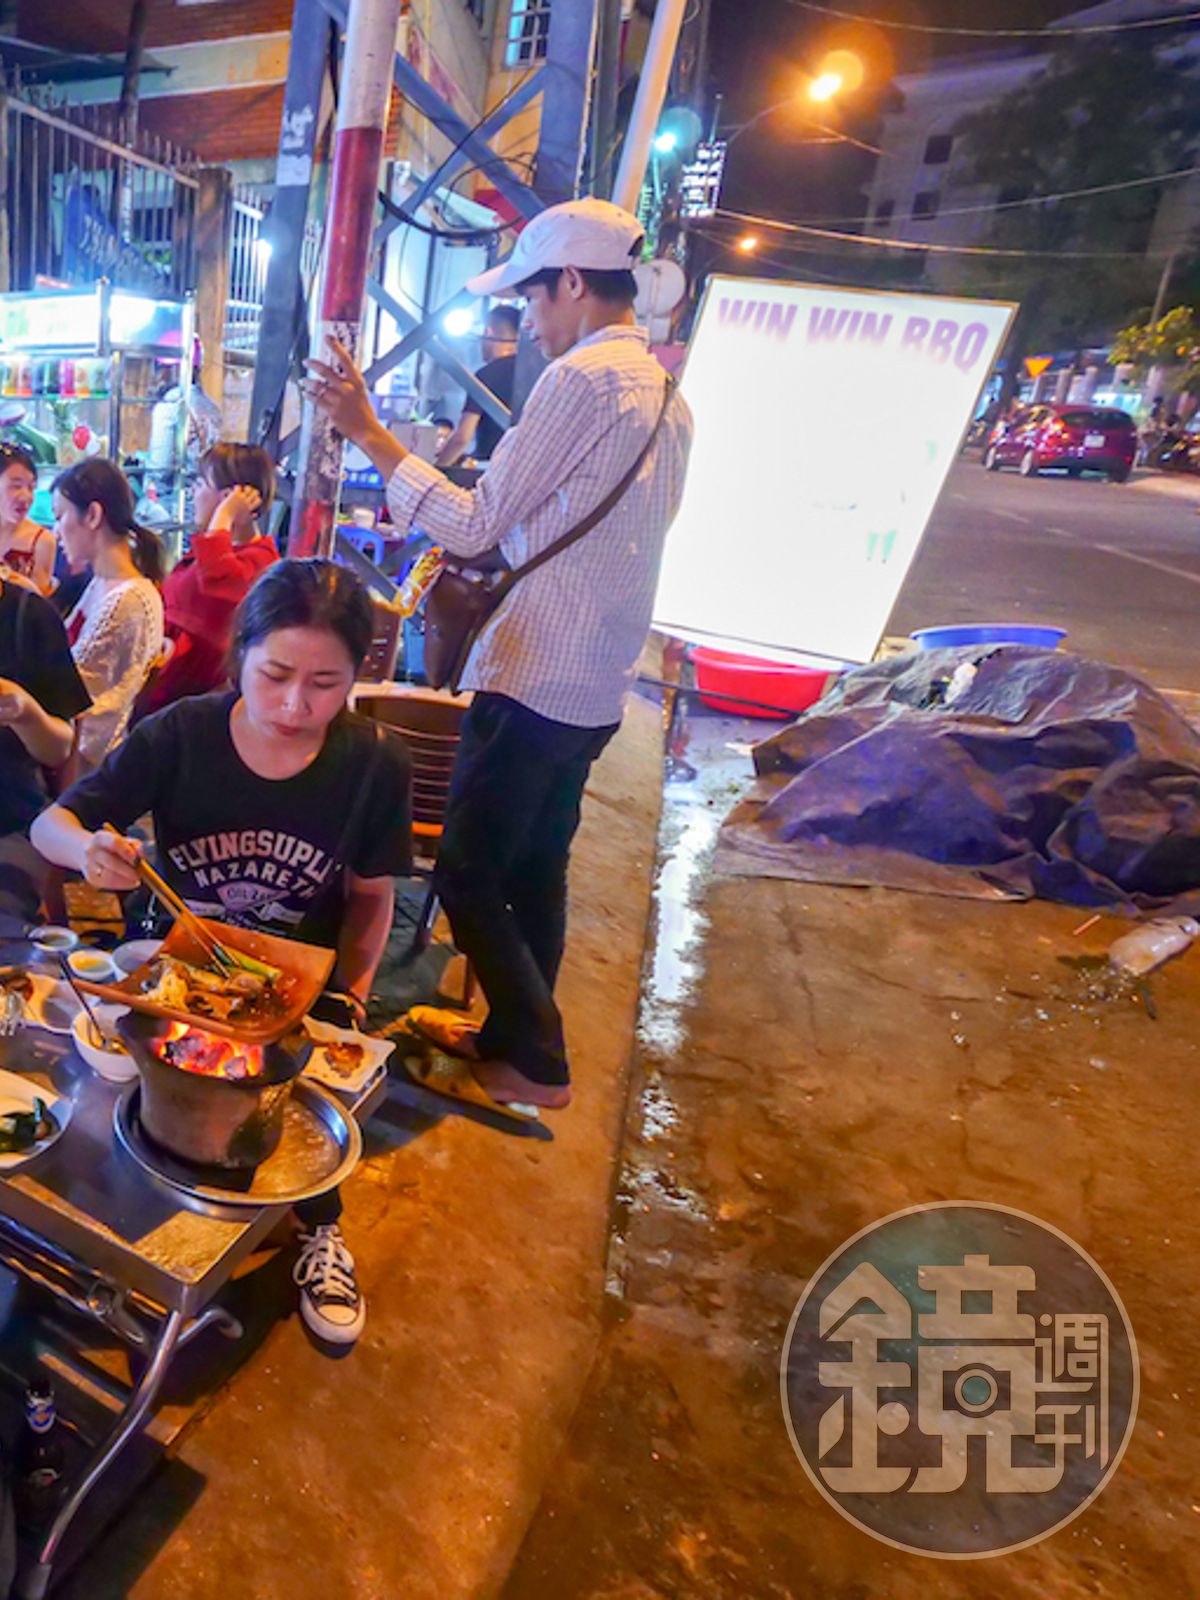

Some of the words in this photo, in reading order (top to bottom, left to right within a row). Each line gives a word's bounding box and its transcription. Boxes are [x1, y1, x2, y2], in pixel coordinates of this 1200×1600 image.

[717, 298, 798, 343] WIN
[807, 306, 893, 345] WIN
[901, 315, 989, 374] BBQ
